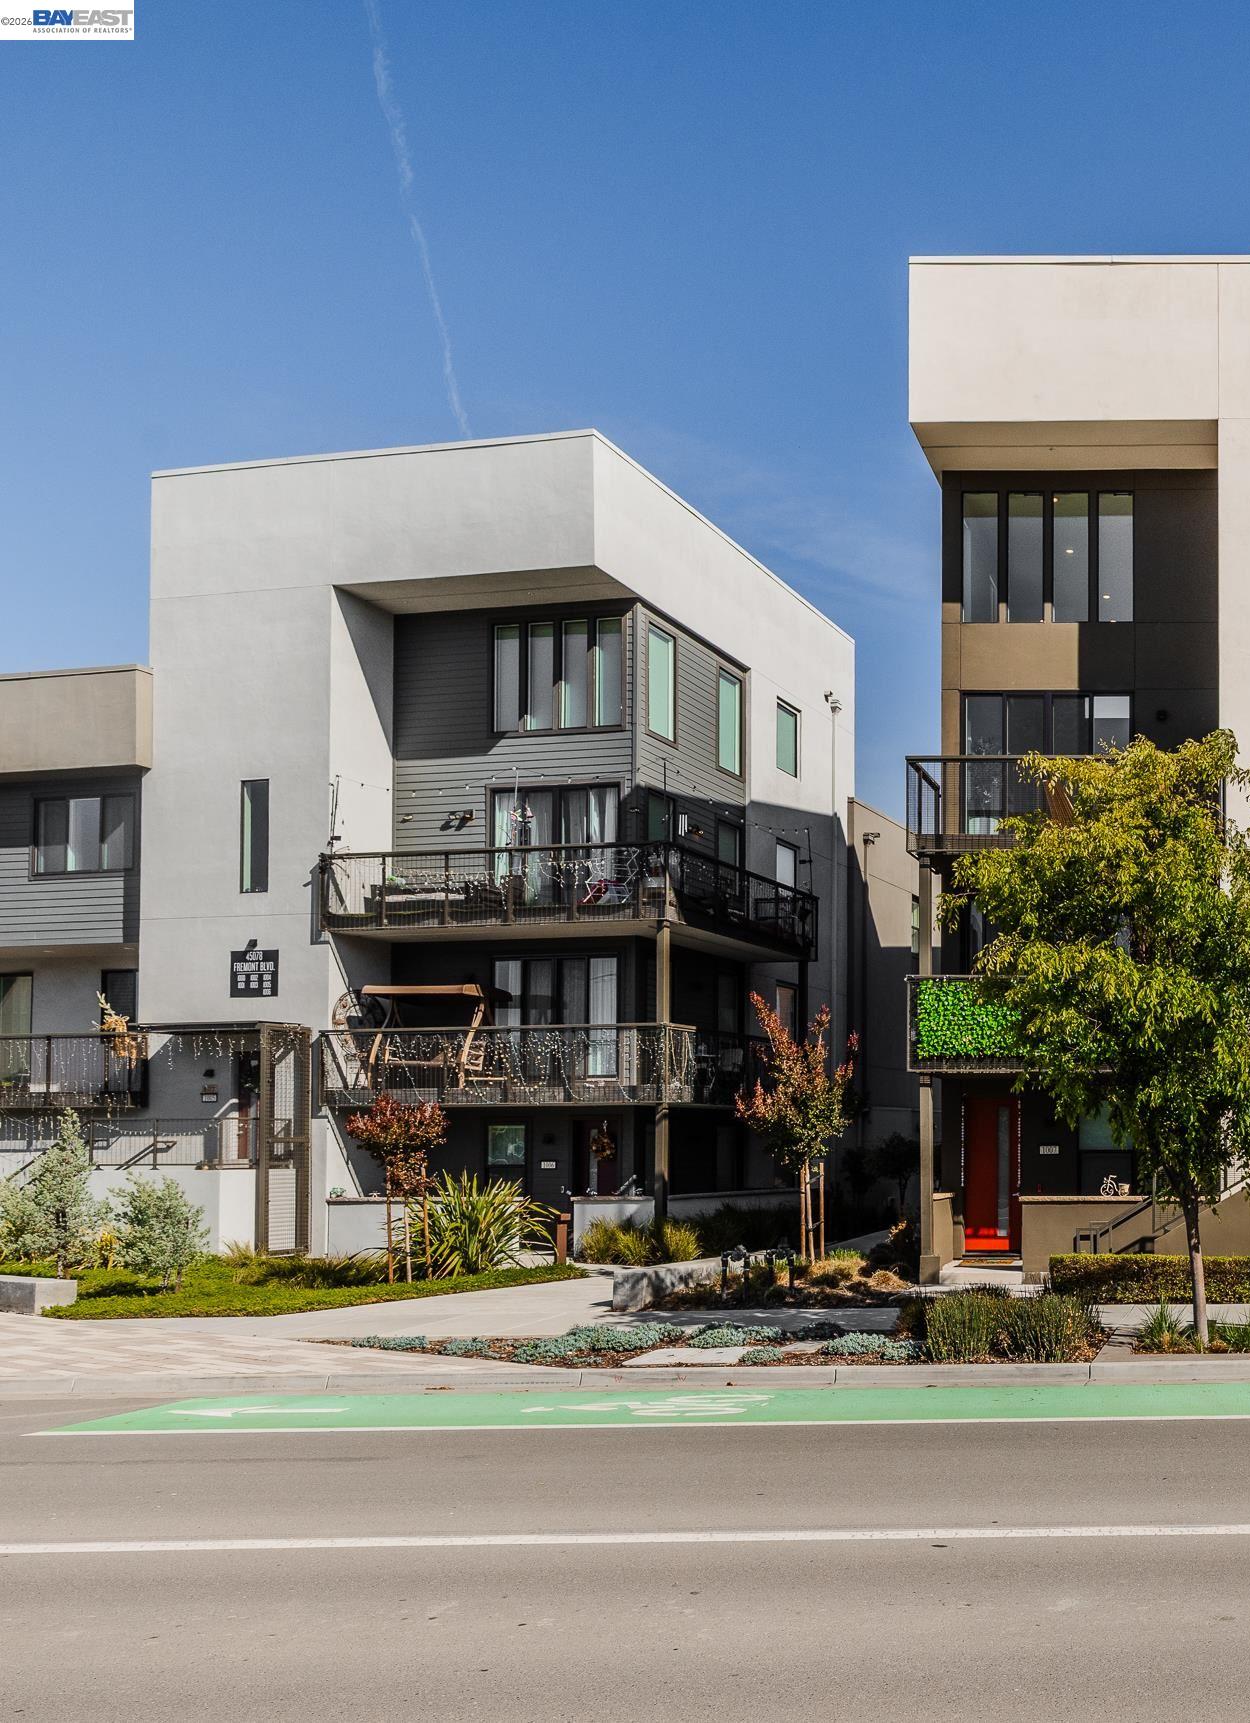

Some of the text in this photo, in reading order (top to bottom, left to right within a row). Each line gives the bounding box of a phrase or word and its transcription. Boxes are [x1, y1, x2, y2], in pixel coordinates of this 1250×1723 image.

[246, 951, 263, 961] 45078
[233, 962, 276, 971] FREMONT BLVD.
